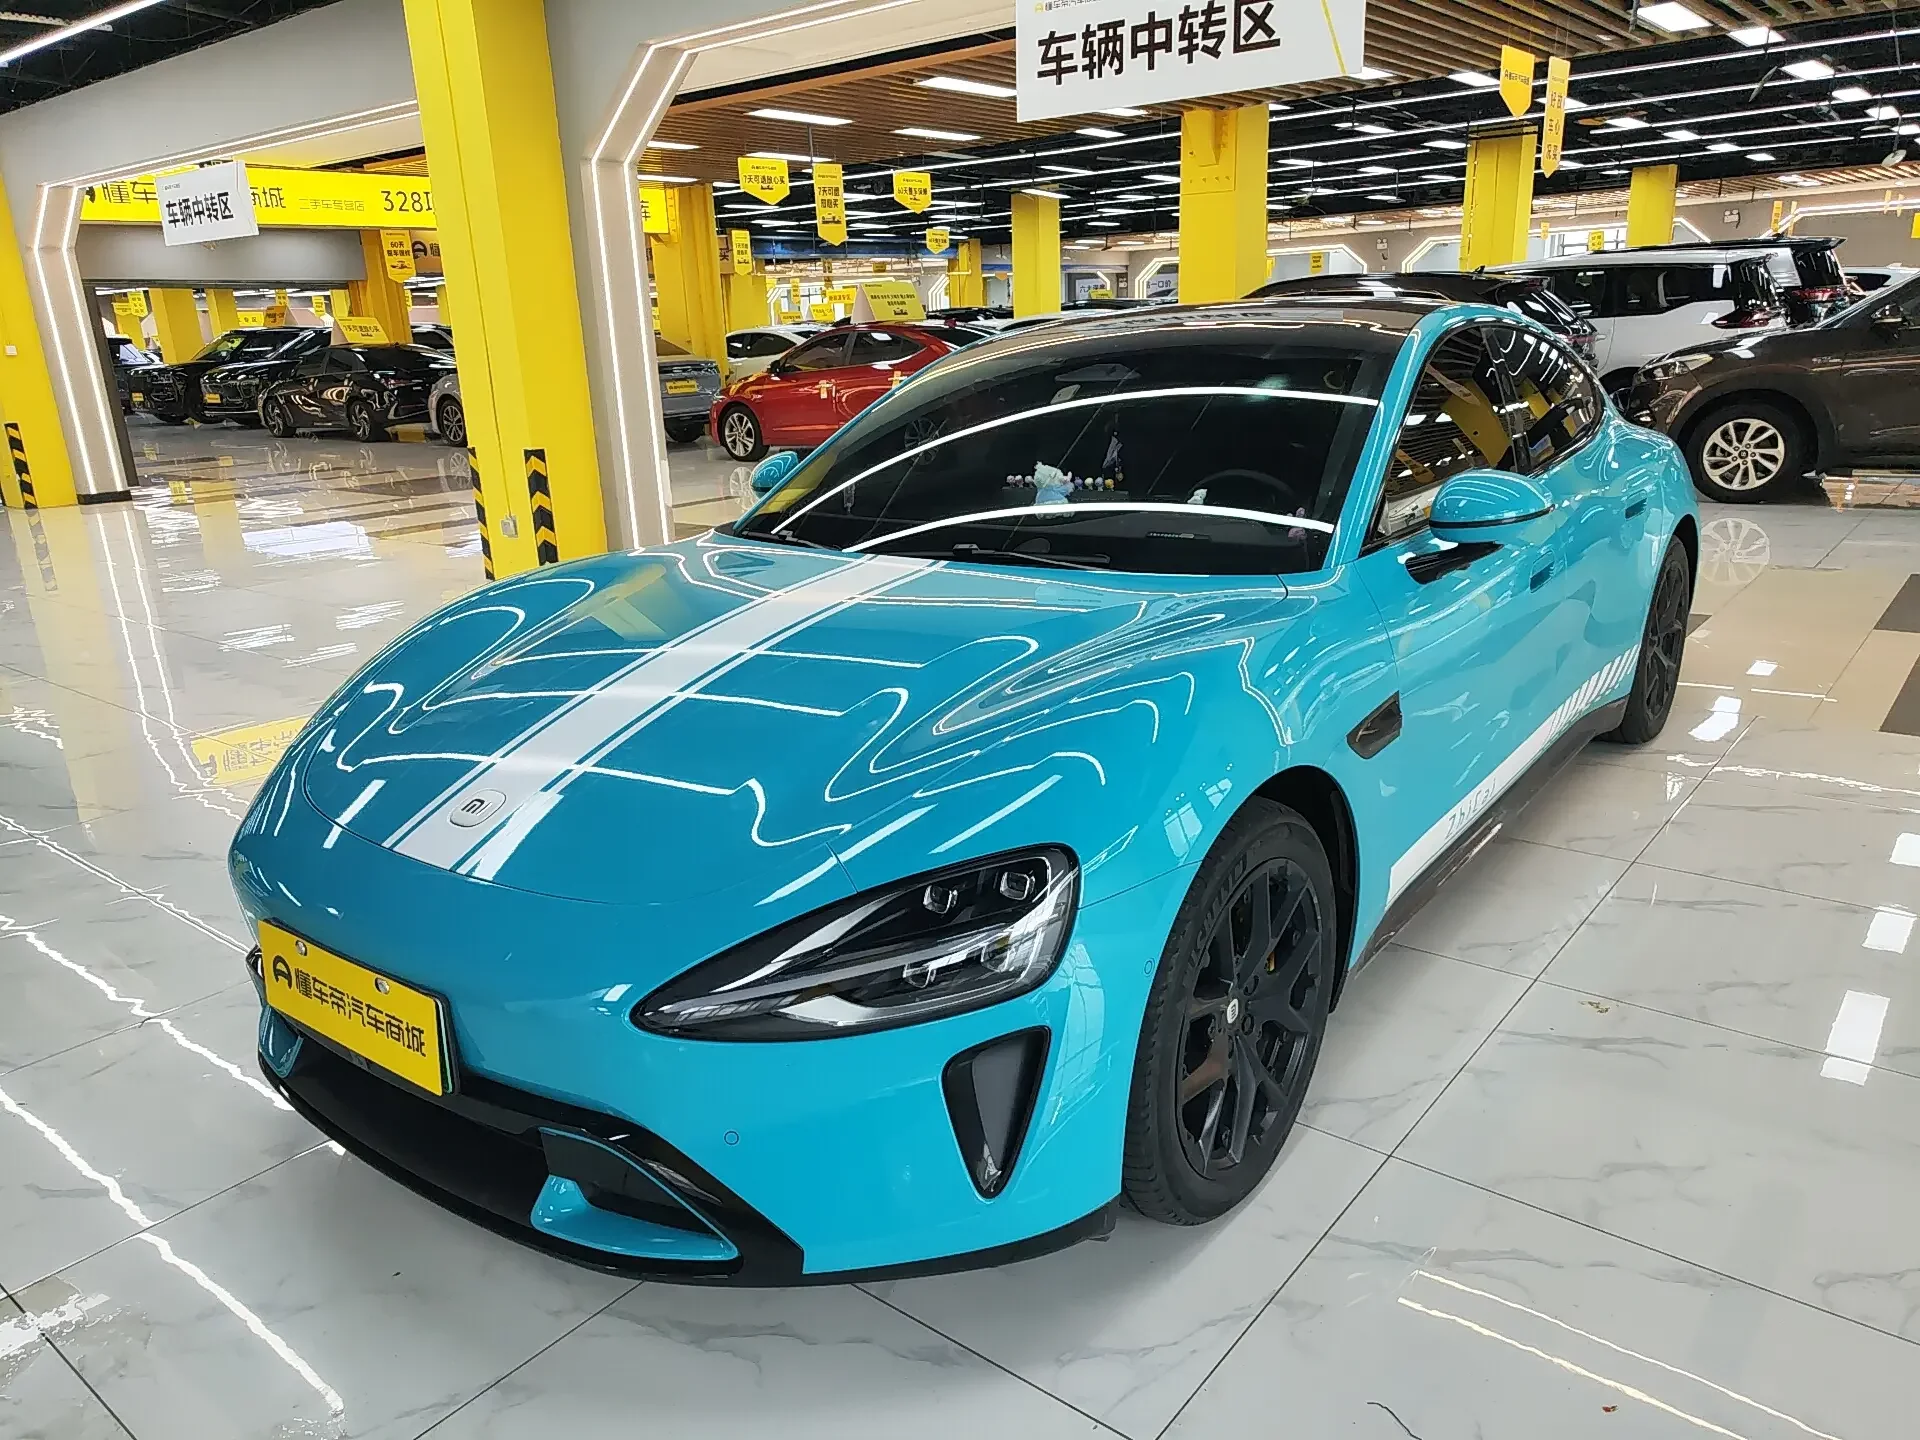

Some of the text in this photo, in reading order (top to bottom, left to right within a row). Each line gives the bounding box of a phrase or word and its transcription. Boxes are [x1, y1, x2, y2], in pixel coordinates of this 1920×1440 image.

[1037, 0, 1281, 86] 车辆中转区
[165, 191, 234, 228] 车辆中转区
[295, 967, 427, 1057] 懂车帝汽车商城
